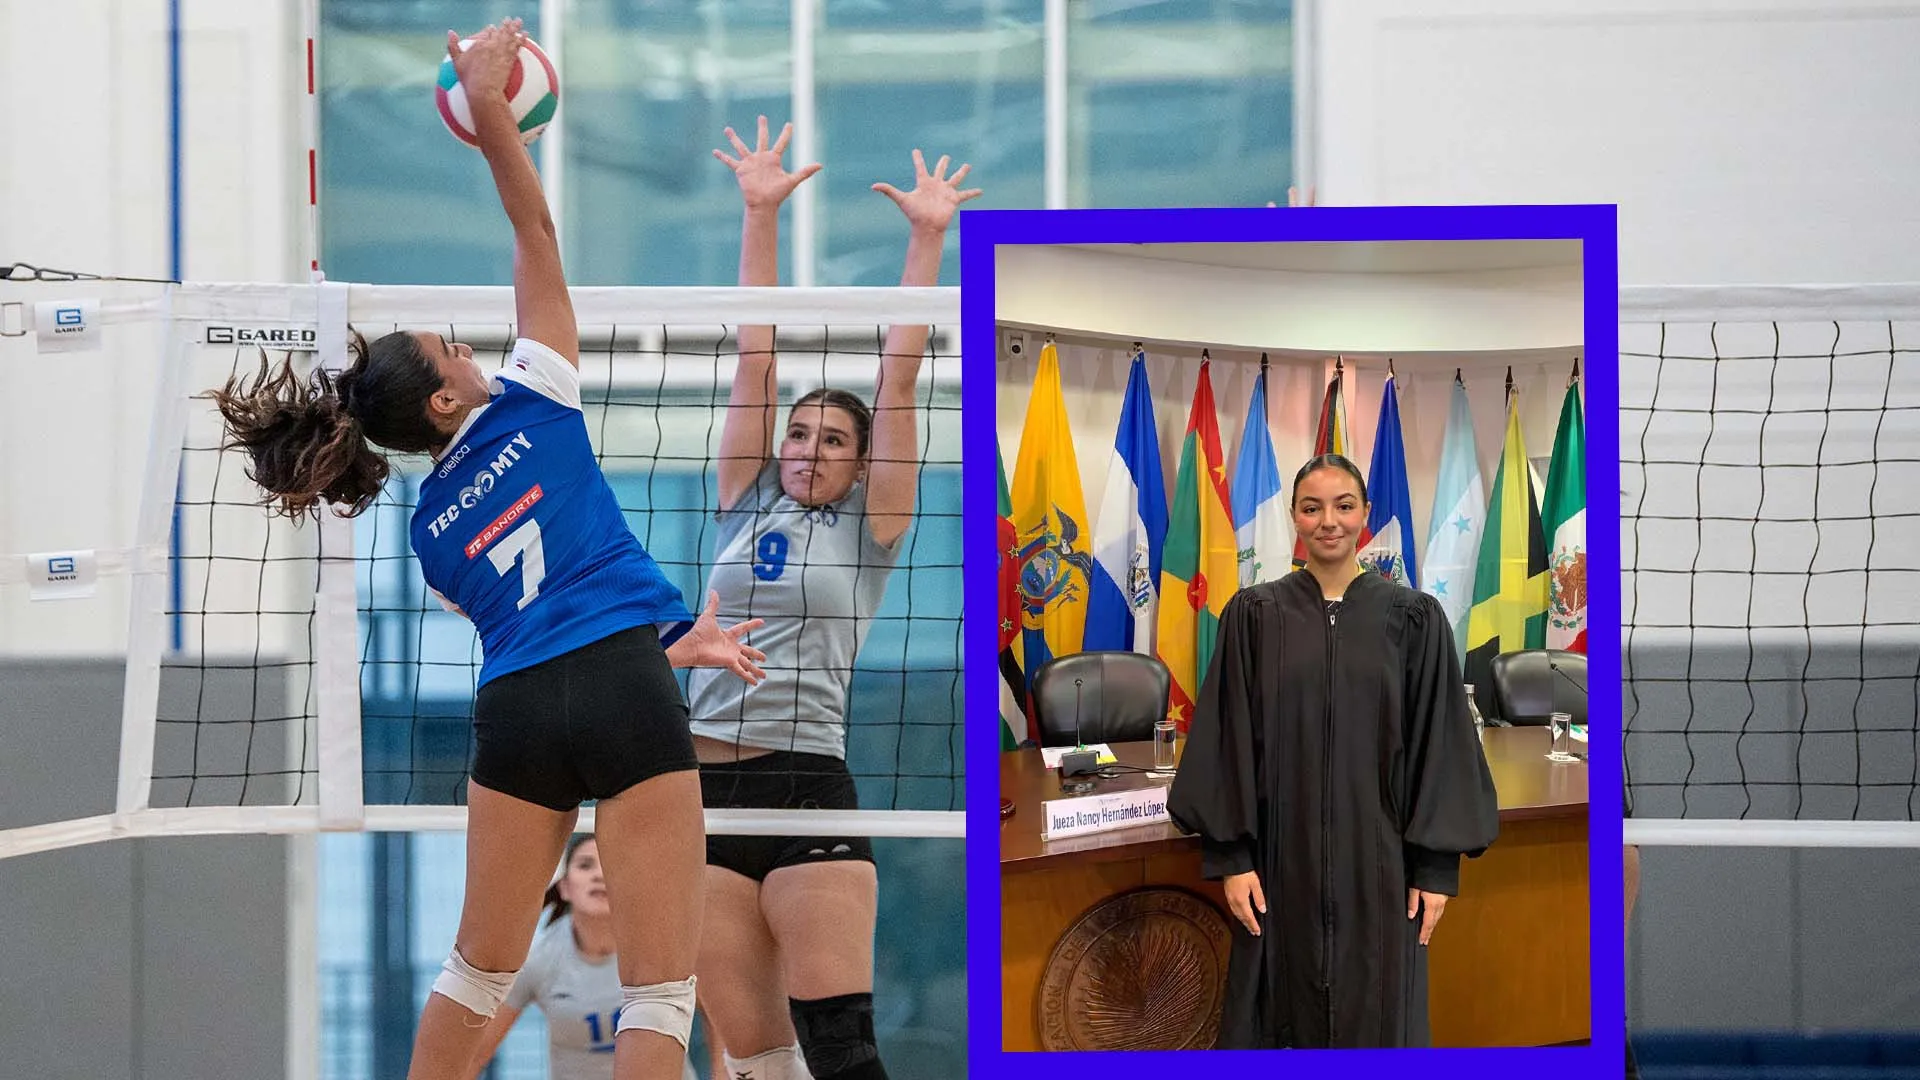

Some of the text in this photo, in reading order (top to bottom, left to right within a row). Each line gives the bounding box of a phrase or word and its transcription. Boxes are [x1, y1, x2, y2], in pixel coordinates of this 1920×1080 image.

[237, 328, 316, 342] GARED
[427, 431, 533, 539] TEC MTY
[438, 444, 471, 479] atletica
[483, 490, 541, 544] BANORTE
[486, 517, 546, 612] 7
[753, 531, 789, 582] 9
[1052, 800, 1165, 831] Jueza Nancy Hernández López
